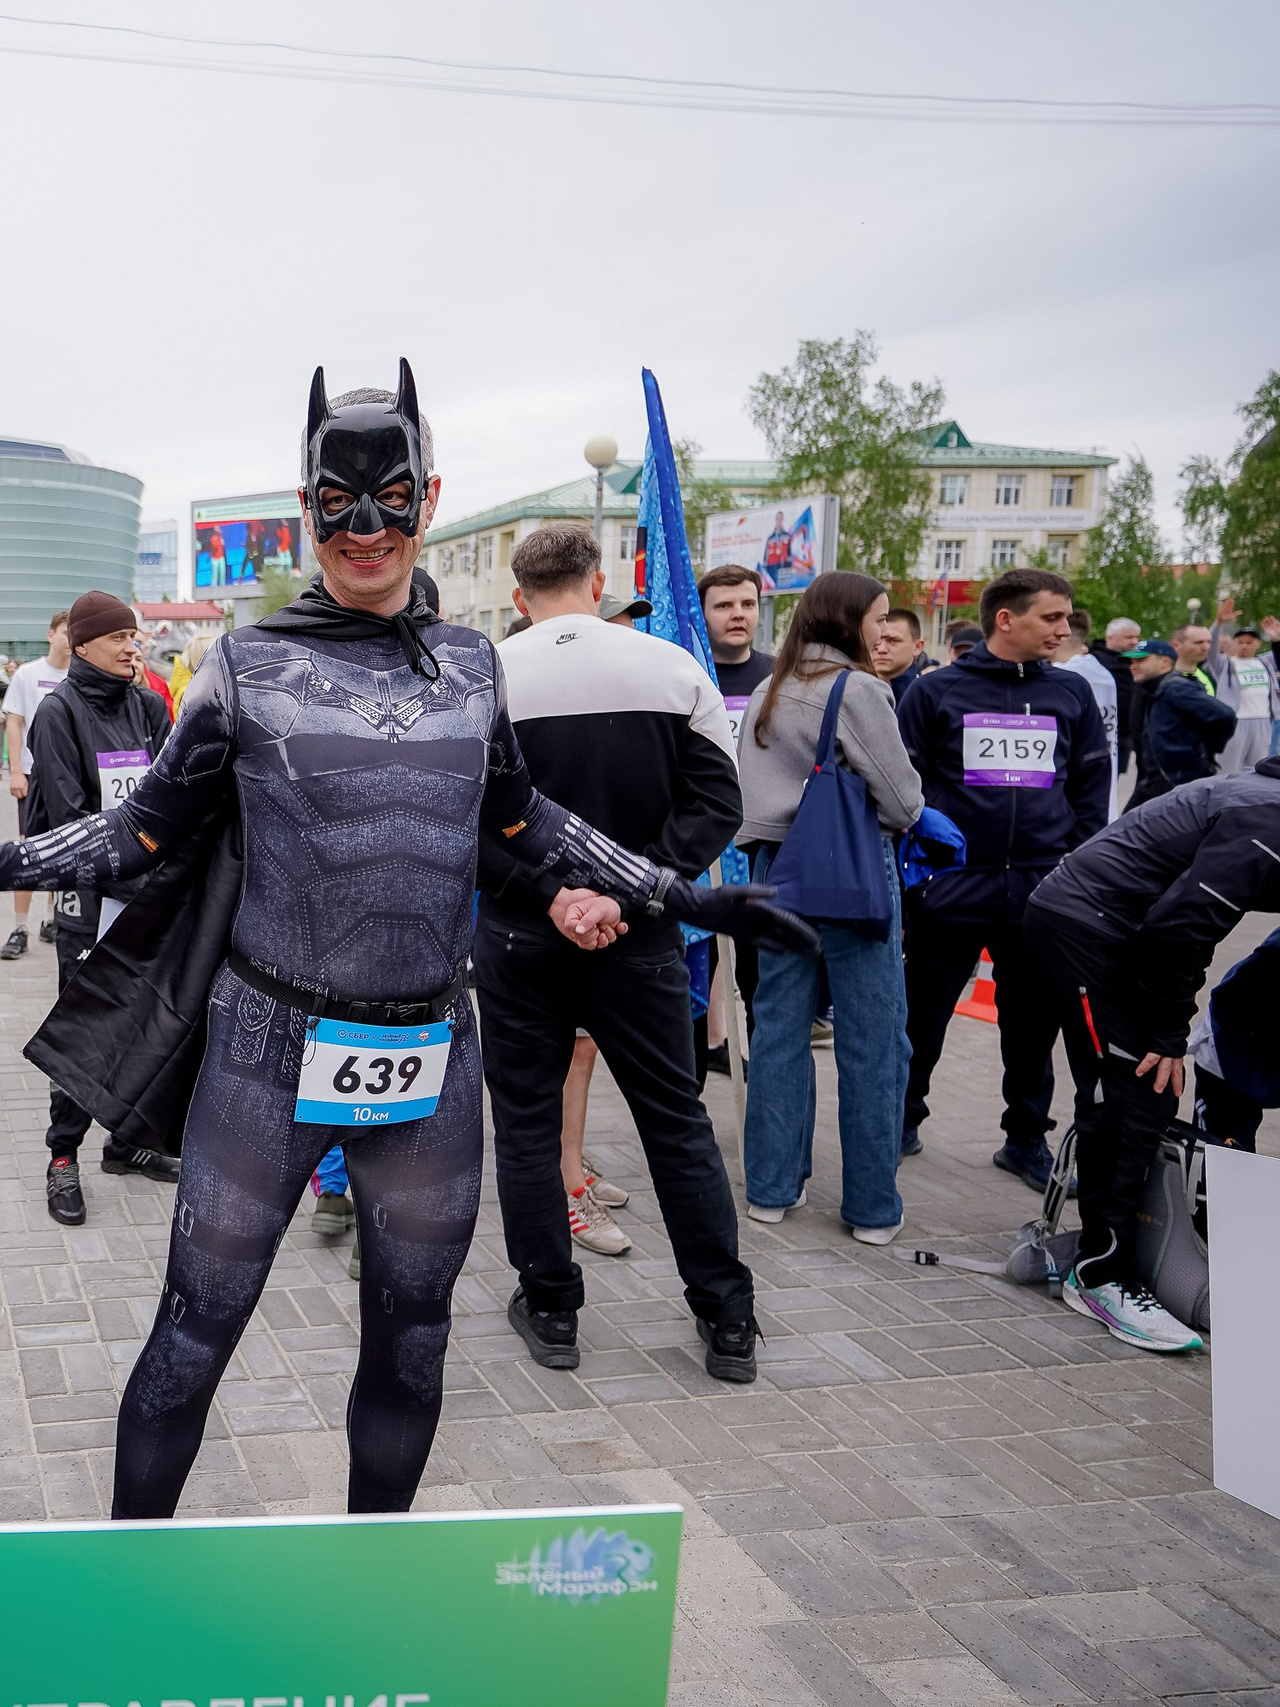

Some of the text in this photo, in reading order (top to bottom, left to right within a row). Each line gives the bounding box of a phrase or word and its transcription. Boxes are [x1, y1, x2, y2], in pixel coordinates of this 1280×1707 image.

[559, 632, 578, 640] NIKE
[979, 738, 1047, 760] 2159
[332, 1055, 423, 1095] 639
